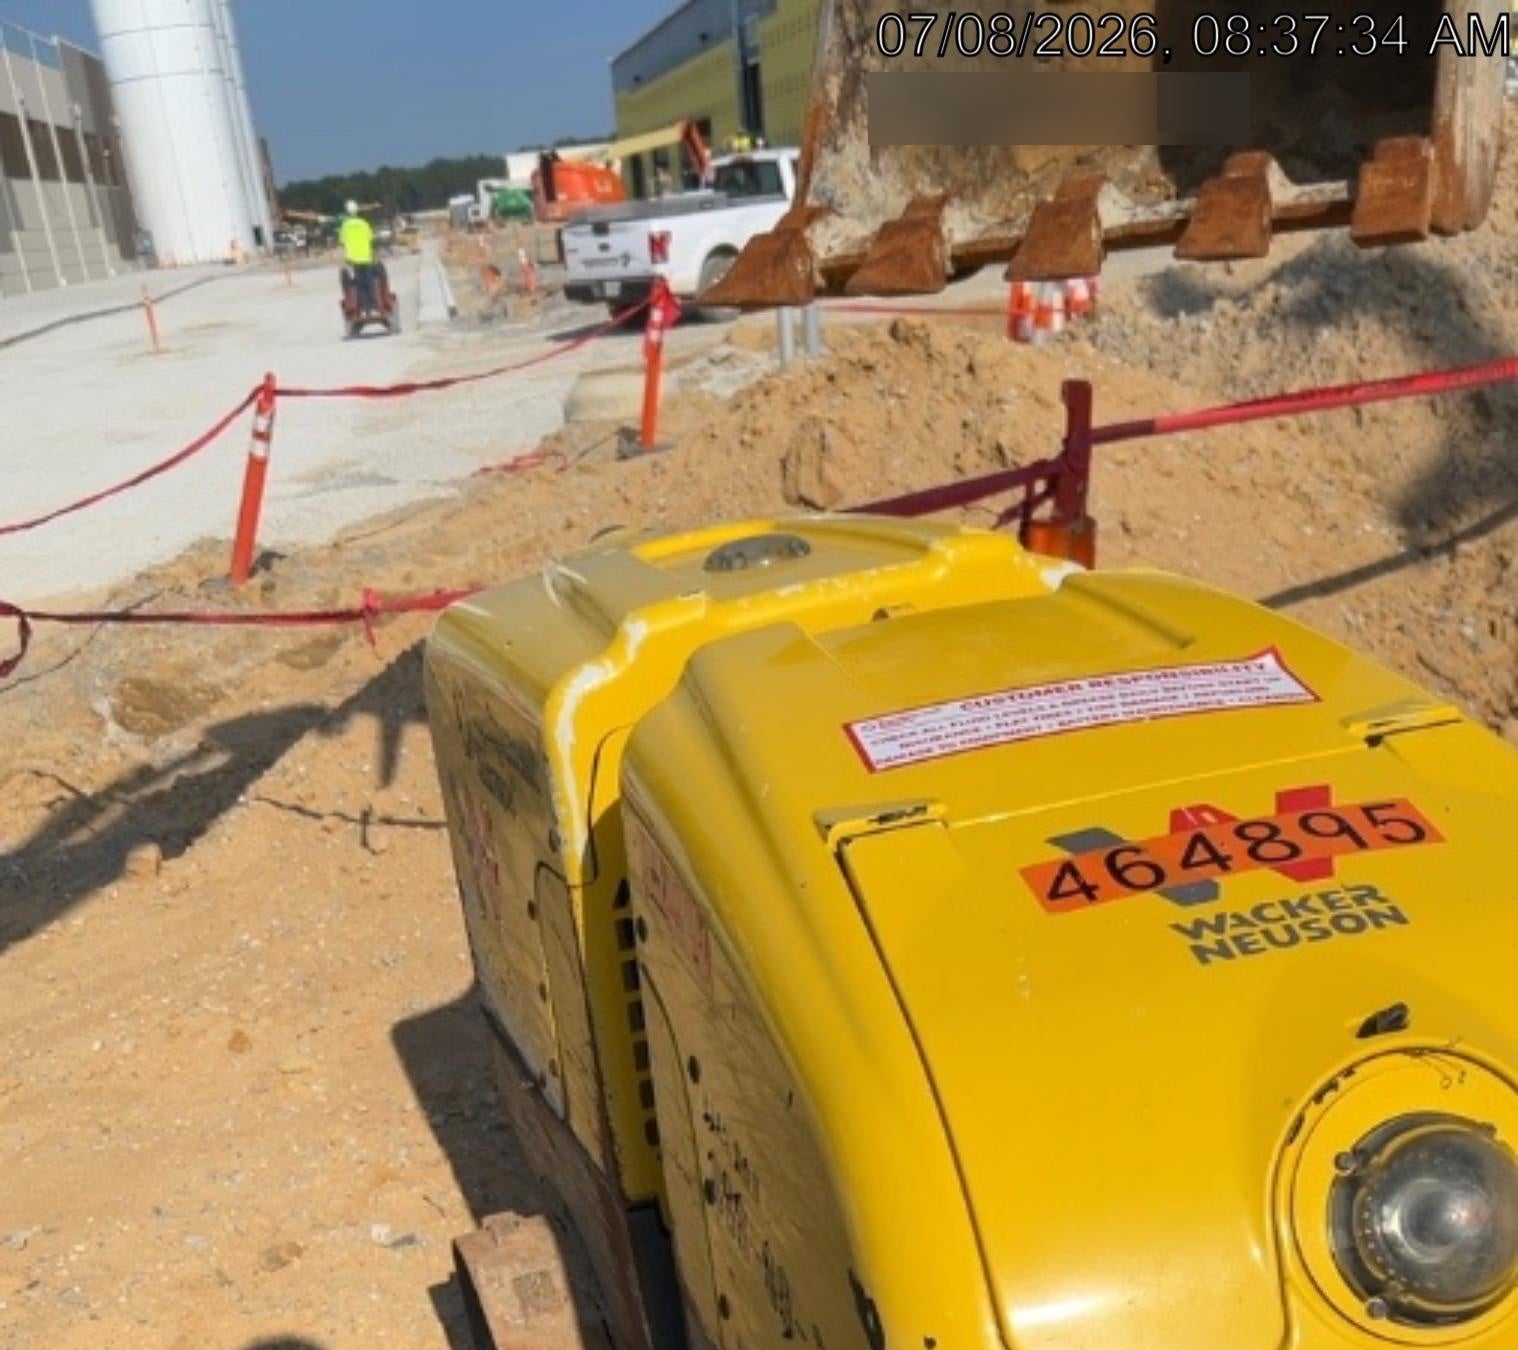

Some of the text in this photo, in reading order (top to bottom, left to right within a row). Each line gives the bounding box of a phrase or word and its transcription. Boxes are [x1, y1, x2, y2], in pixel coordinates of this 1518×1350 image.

[959, 662, 1265, 711] CUSTOMER RESPONSIBILITY
[1047, 803, 1426, 902] 464895
[1169, 884, 1392, 940] WACKER
[1189, 906, 1410, 965] NEUSON
